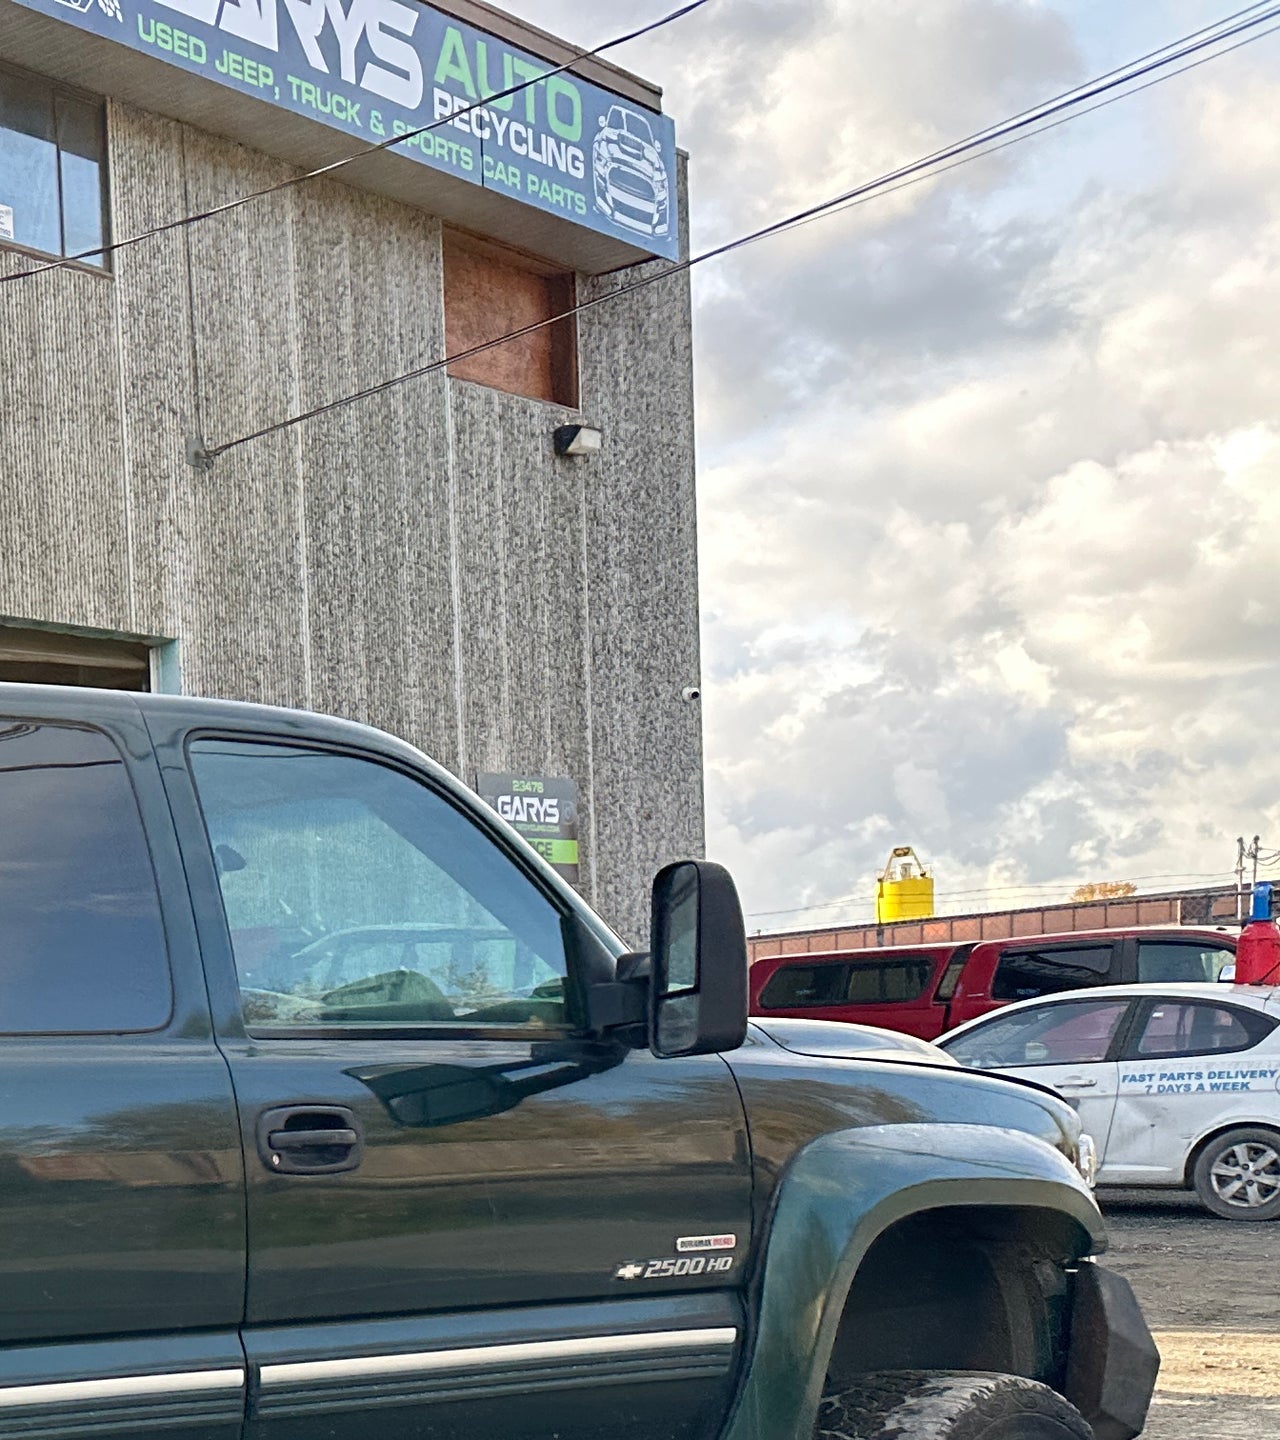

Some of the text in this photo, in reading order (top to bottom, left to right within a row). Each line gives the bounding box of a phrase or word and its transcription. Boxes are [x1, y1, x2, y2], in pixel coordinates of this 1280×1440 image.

[152, 0, 426, 110] RYS
[433, 25, 583, 142] AUTO
[136, 13, 588, 216] USED JEEP, TRUCK & SPORTS CAR PARTS
[432, 86, 585, 180] RECYCLING
[497, 794, 560, 824] GARYS
[1121, 1069, 1278, 1083] FAST PARTS DELIVERY
[1145, 1081, 1251, 1095] 7 DAYS A WEEK
[644, 1256, 733, 1279] 2500 HD
